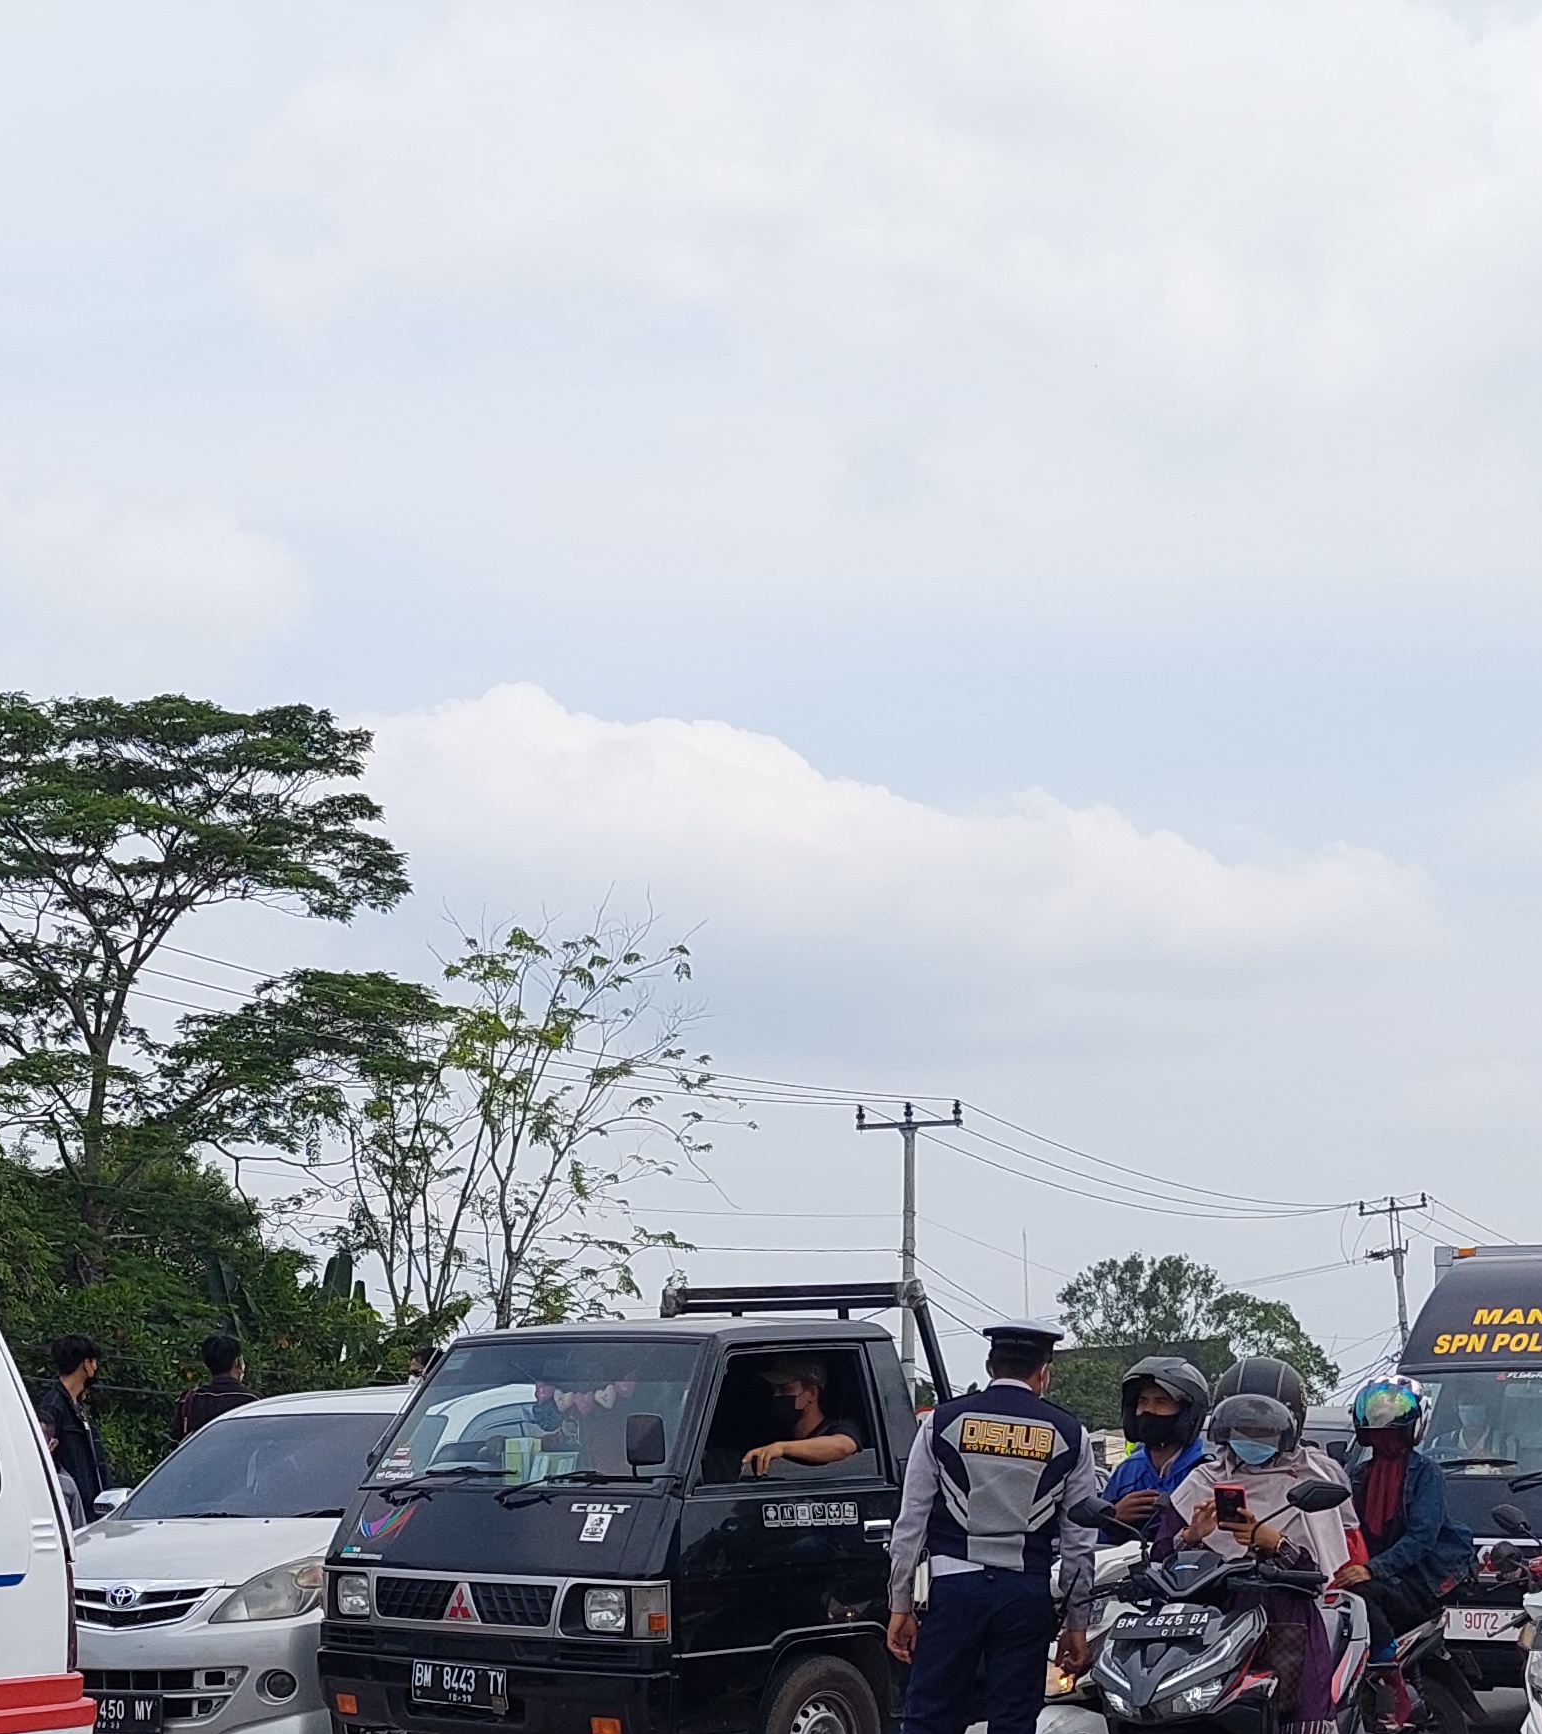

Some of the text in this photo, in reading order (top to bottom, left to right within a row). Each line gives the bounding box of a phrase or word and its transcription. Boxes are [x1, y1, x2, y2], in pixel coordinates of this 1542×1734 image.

[1433, 1332, 1488, 1354] SPN
[962, 1420, 1054, 1454] DISHUB
[965, 1443, 990, 1453] KOTA
[570, 1503, 632, 1514] COLT
[1116, 1617, 1139, 1629] BM
[1189, 1612, 1209, 1625] BA
[1464, 1611, 1499, 1630] 9072
[414, 1663, 504, 1696] BM 8443 TY
[134, 1700, 154, 1720] MY
